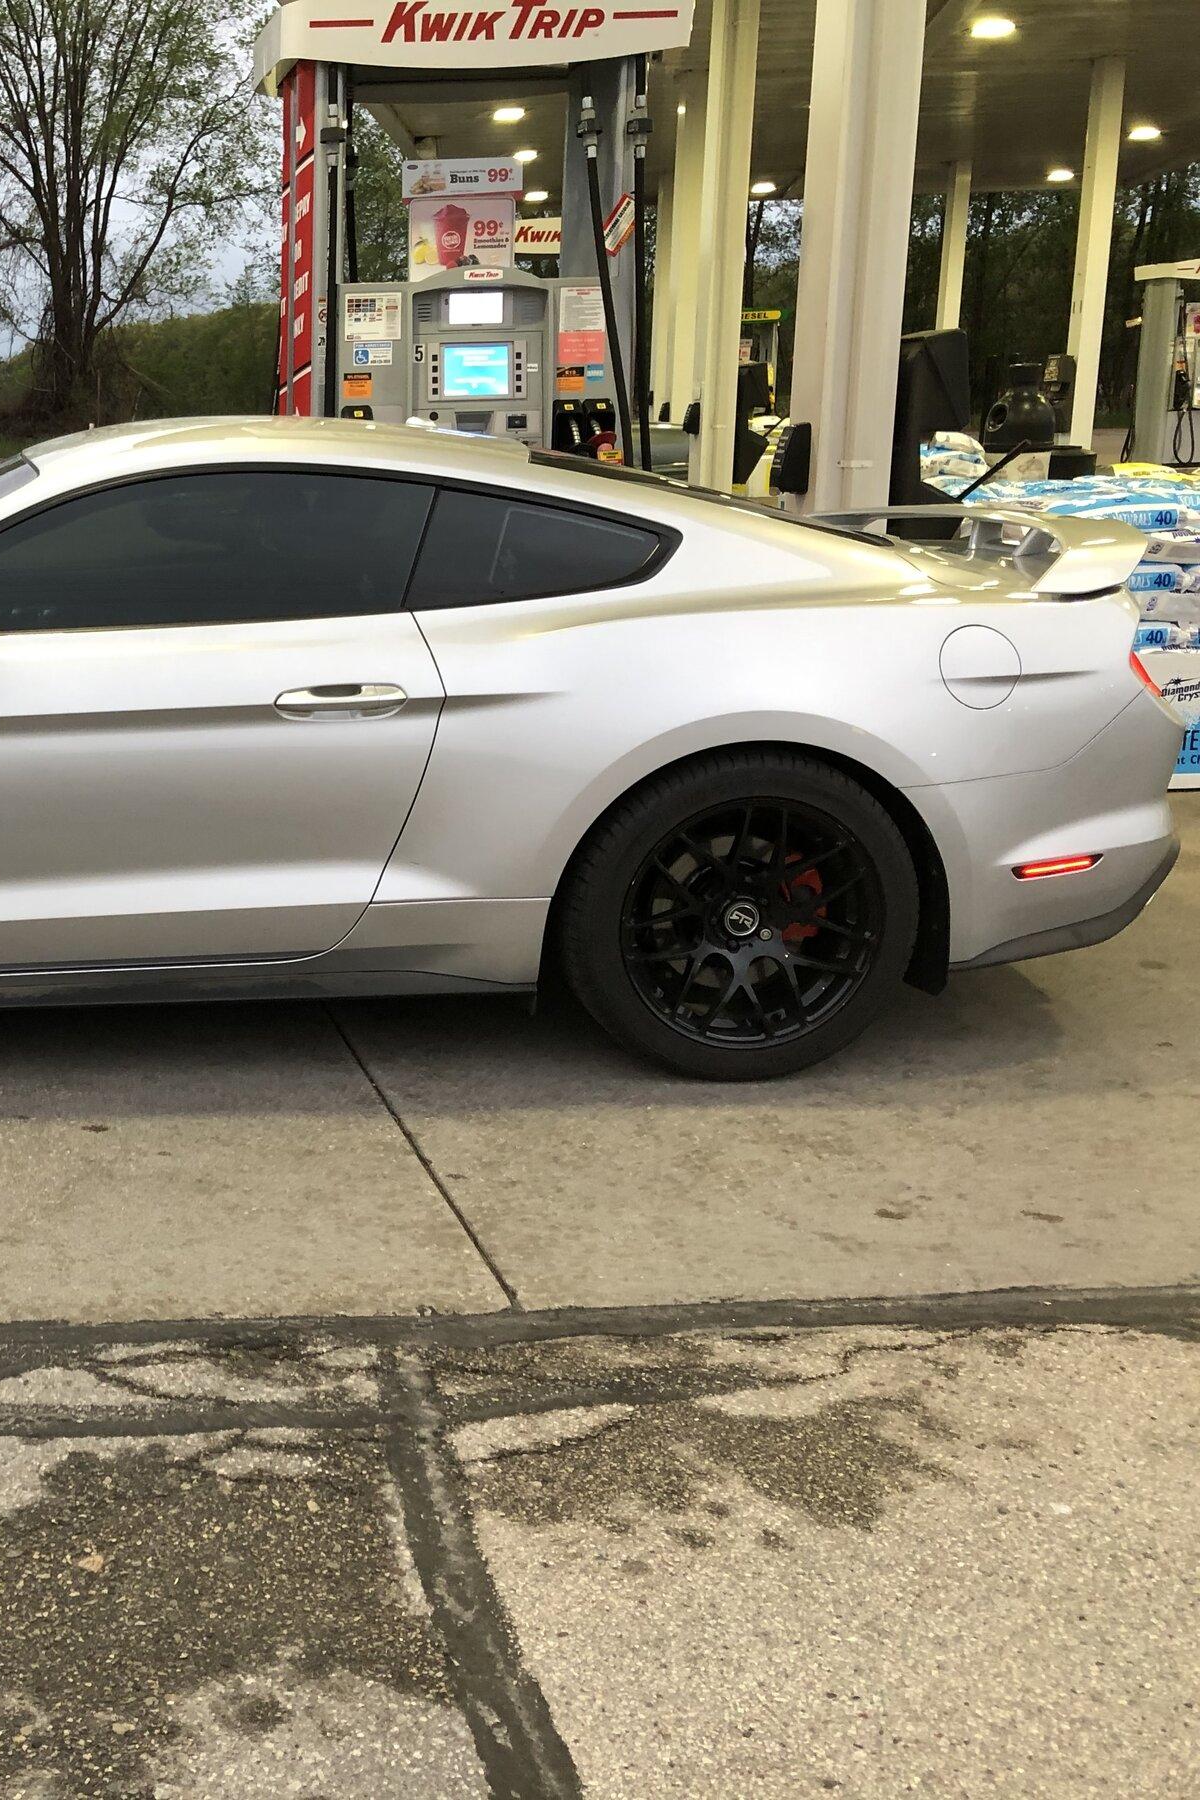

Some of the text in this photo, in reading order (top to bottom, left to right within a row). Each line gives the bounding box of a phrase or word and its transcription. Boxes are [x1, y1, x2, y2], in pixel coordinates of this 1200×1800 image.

[381, 0, 605, 43] KWIK TRIP
[449, 174, 480, 184] Buns
[741, 312, 769, 320] IESEL
[414, 345, 424, 362] 5
[1154, 511, 1173, 526] 40
[1153, 573, 1172, 588] 40
[1145, 630, 1164, 644] 40
[1161, 681, 1200, 697] Diamond
